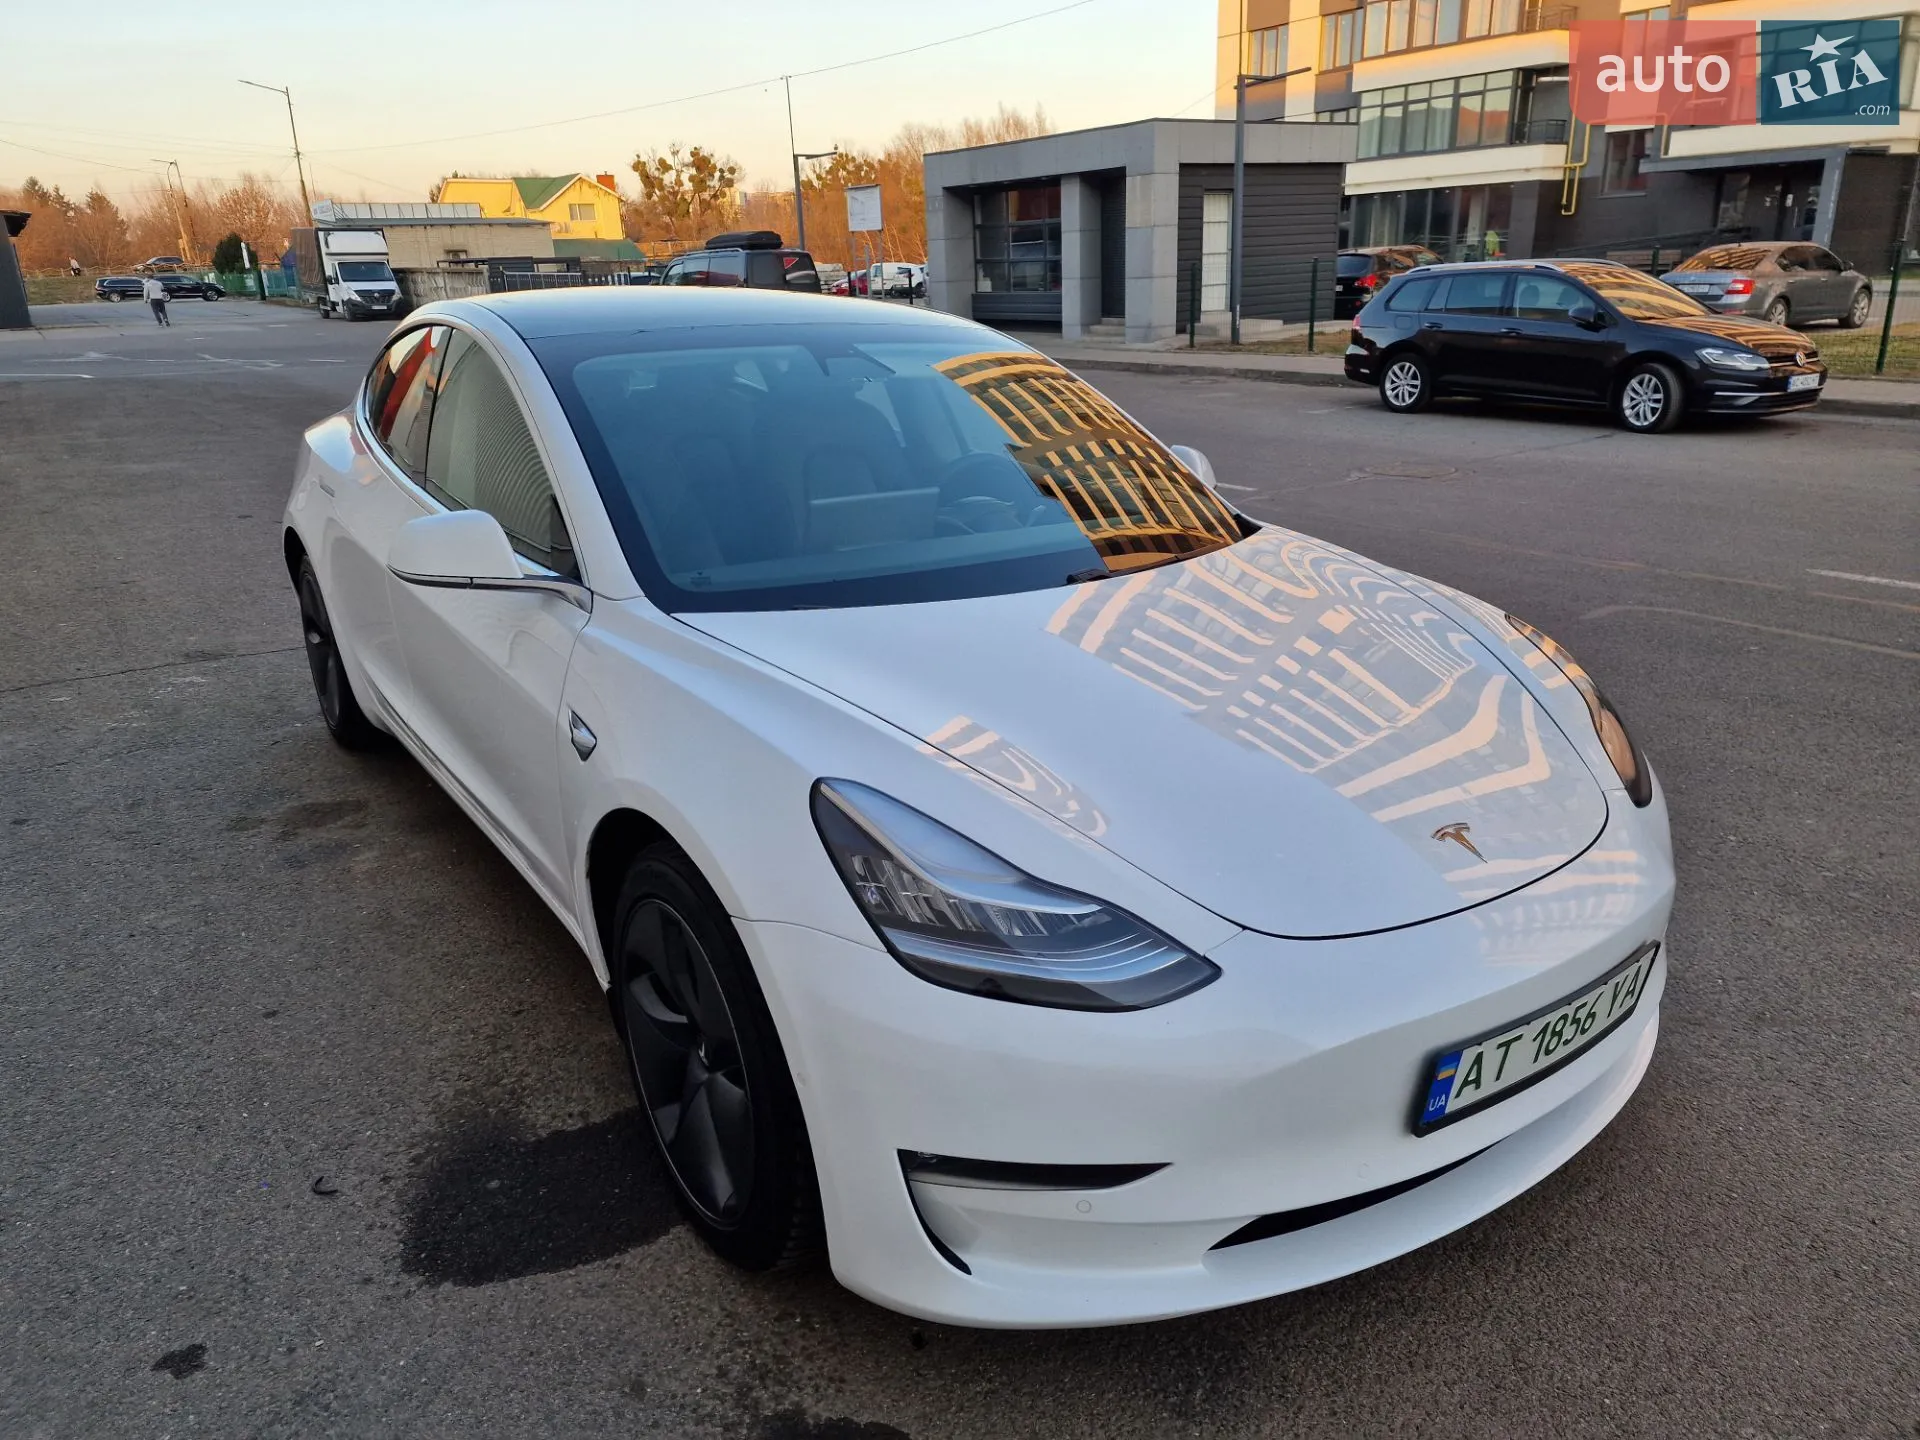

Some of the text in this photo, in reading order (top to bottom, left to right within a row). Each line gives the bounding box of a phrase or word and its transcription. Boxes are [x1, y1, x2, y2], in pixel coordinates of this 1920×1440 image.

[1454, 964, 1643, 1100] AT 1856 YA
[1428, 1093, 1446, 1112] UA
